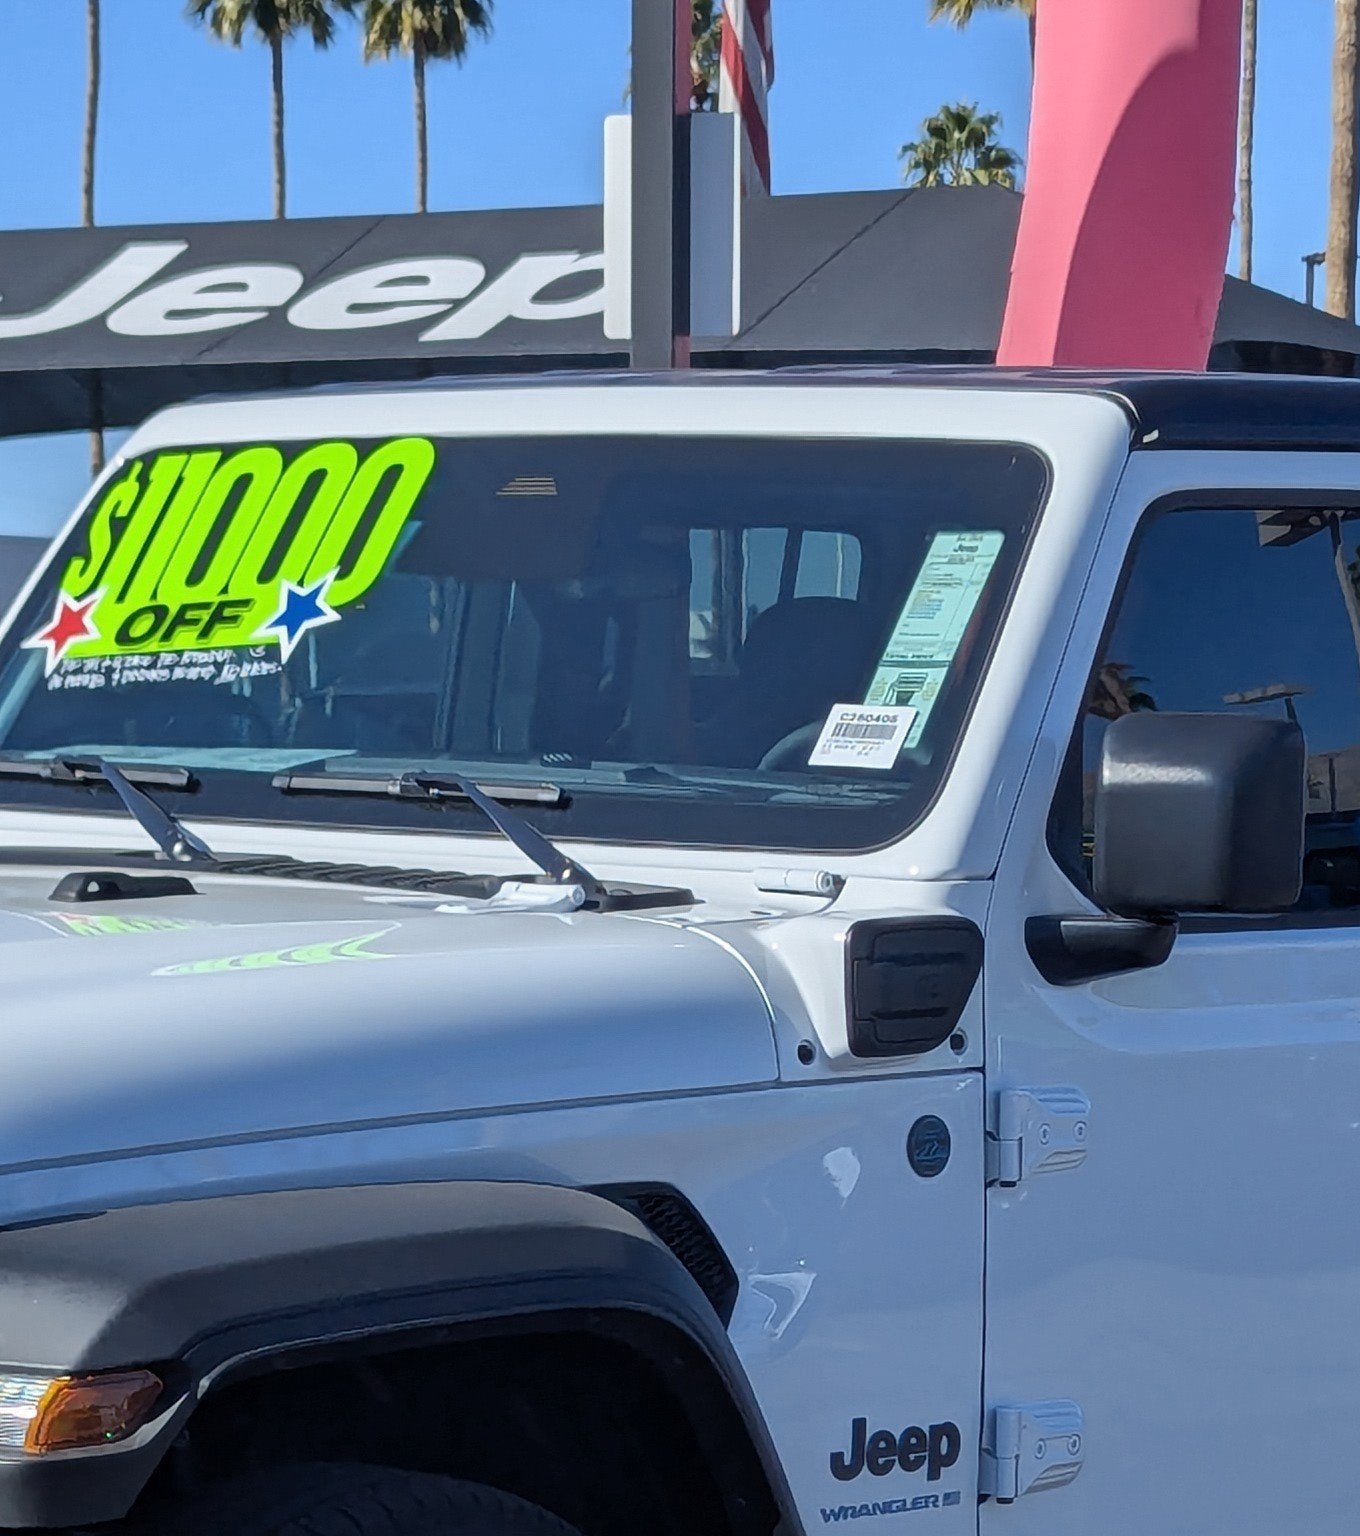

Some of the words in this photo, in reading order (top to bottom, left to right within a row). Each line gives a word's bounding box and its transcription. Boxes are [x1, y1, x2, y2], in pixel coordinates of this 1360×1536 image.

[60, 436, 436, 608] $11000
[114, 598, 256, 647] OFF
[830, 1417, 961, 1481] Jeep
[820, 1494, 940, 1523] WRANGLER
